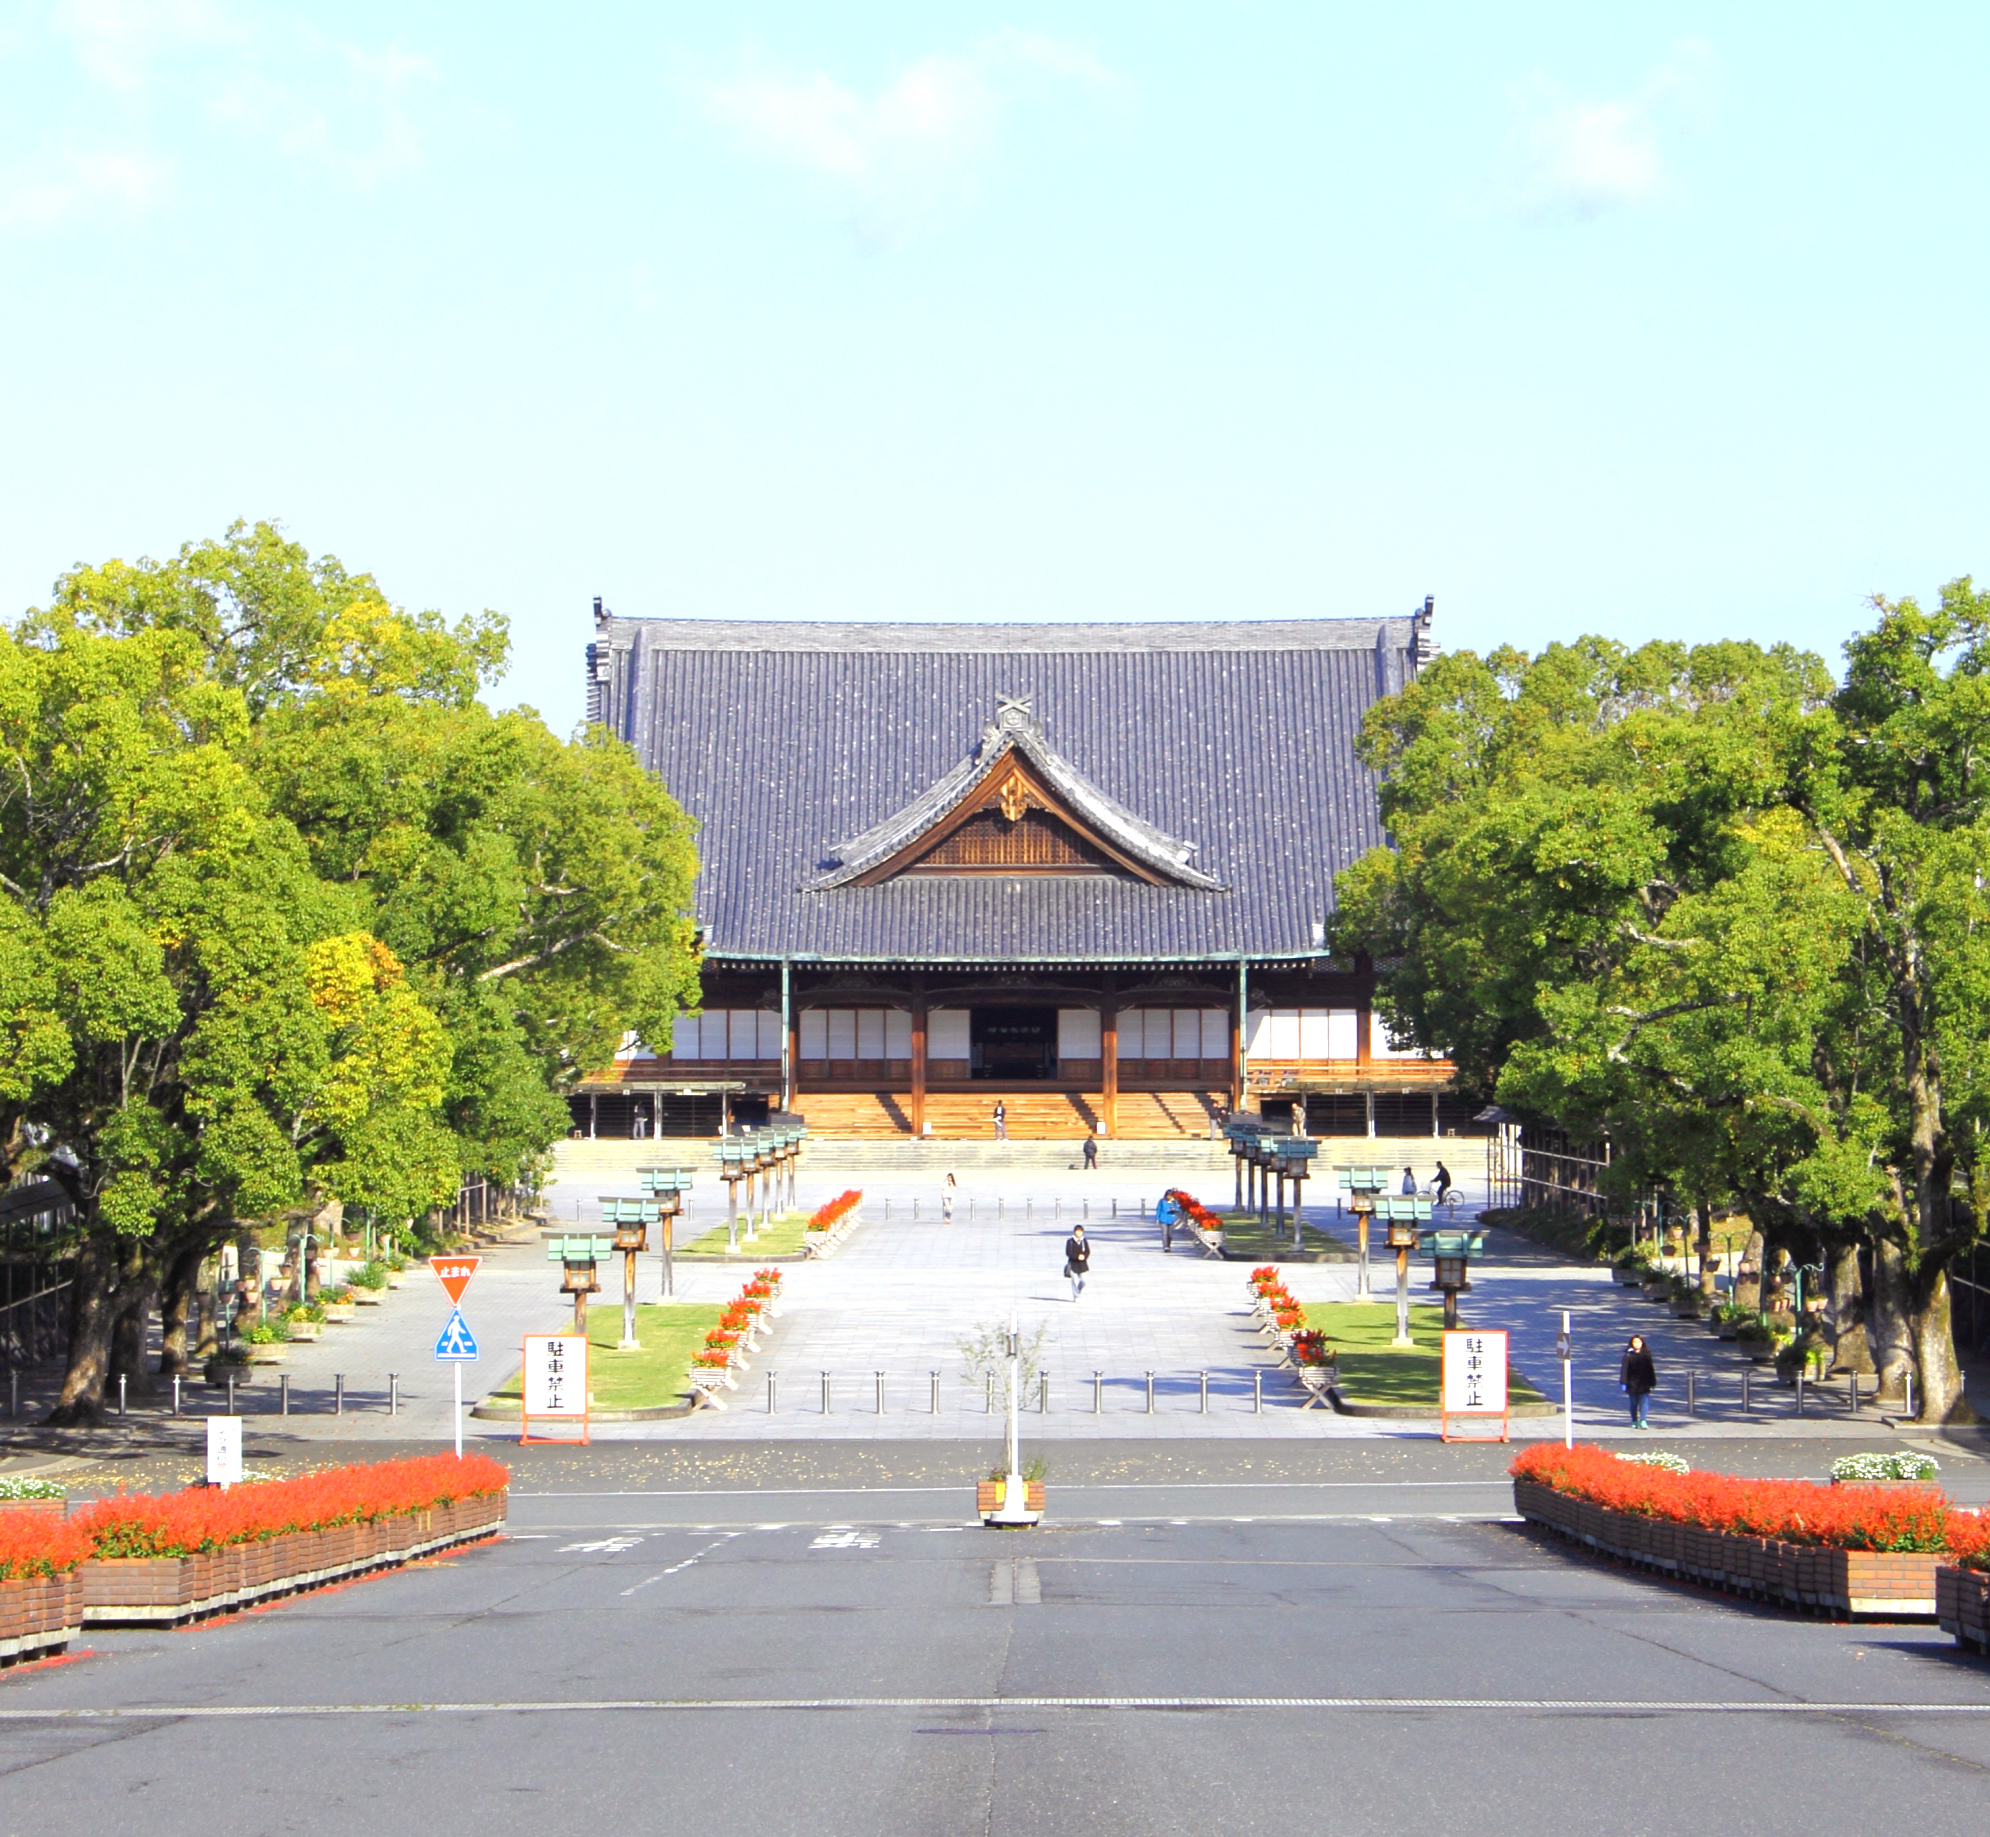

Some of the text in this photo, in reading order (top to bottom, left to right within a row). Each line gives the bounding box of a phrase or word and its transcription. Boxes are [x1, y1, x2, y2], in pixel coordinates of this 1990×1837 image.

[439, 1266, 471, 1278] 止まれ
[546, 1341, 564, 1409] 駐車禁止
[1465, 1338, 1484, 1406] 駐車禁止
